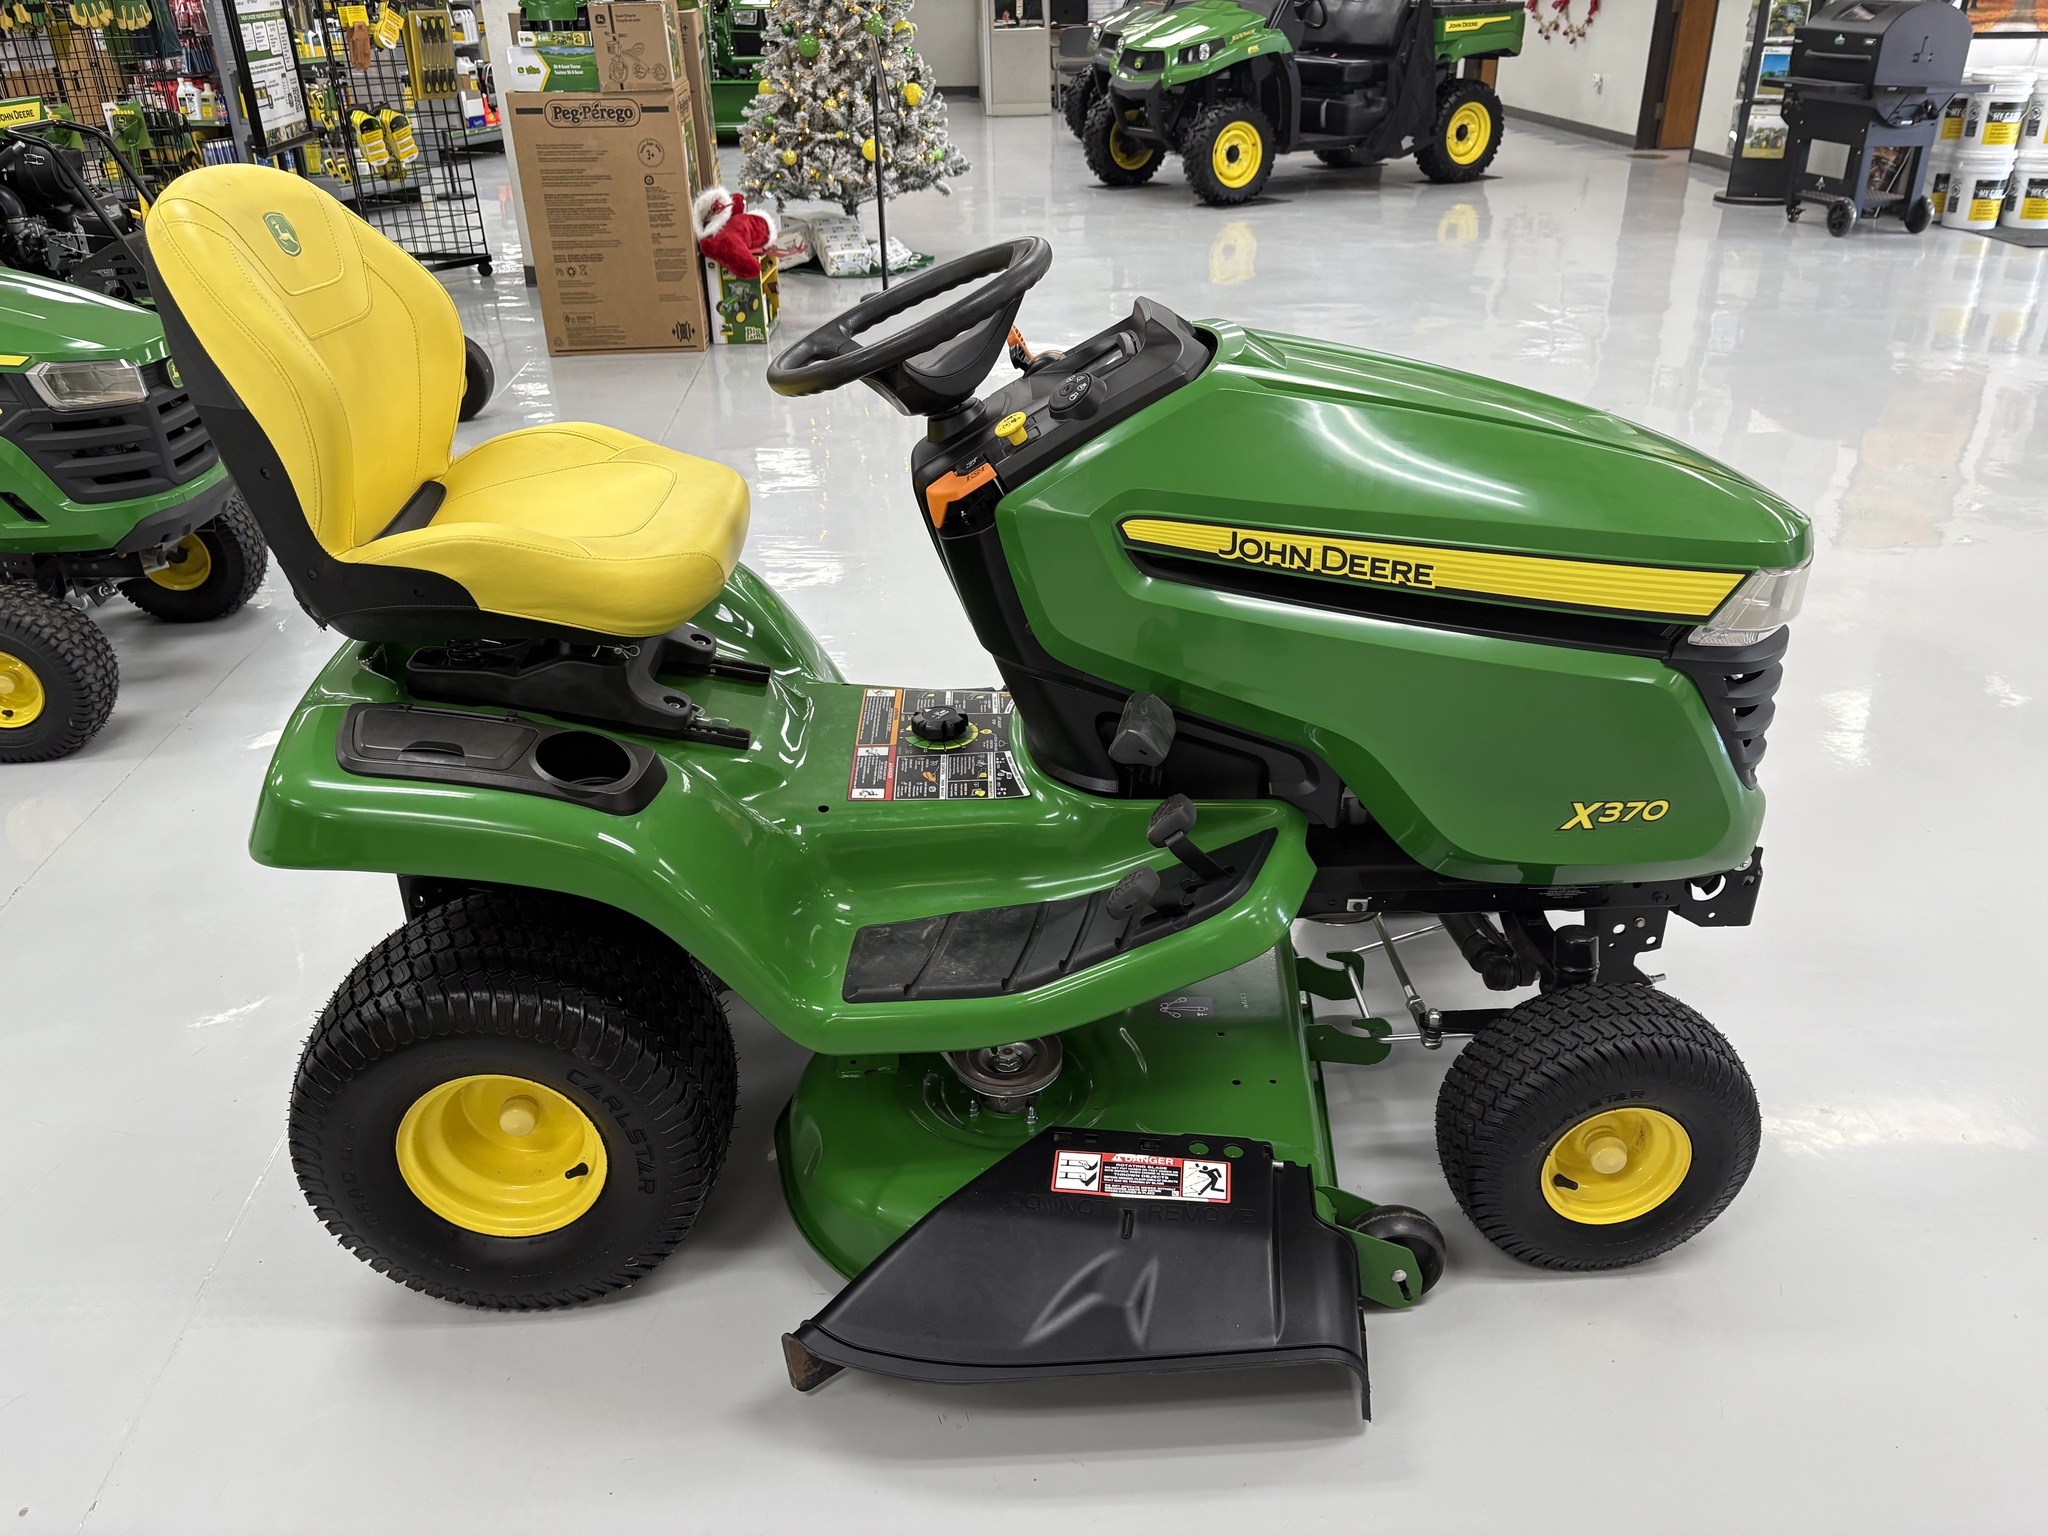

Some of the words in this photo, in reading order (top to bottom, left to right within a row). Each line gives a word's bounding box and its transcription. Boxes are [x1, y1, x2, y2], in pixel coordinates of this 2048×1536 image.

[13, 110, 34, 120] DEERE
[1218, 531, 1312, 568] JOHN
[1321, 545, 1434, 586] DEERE
[1555, 799, 1670, 831] X370
[566, 1068, 656, 1195] CARLSTAR
[1124, 1155, 1174, 1165] DANGER
[1147, 1202, 1257, 1224] REMOVE
